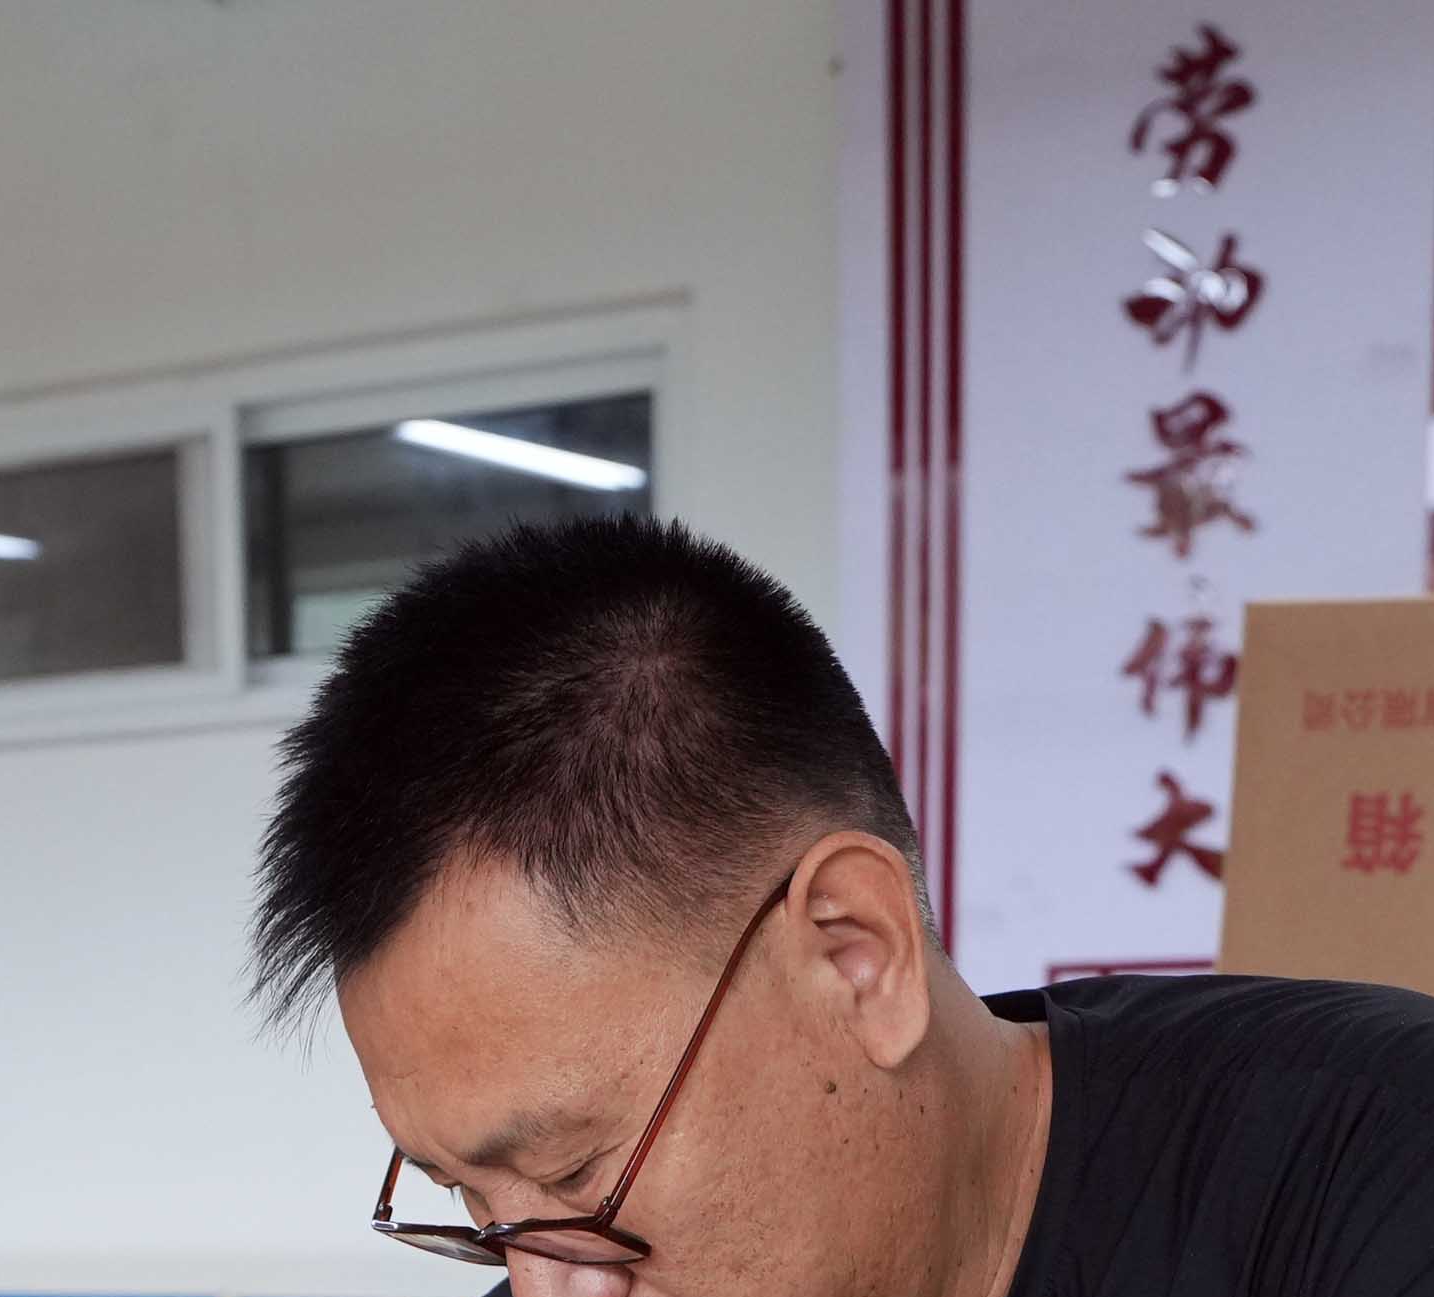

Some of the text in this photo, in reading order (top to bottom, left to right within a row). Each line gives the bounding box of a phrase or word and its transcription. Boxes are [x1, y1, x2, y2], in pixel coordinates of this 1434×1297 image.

[1120, 22, 1267, 888] 劳动最伟大
